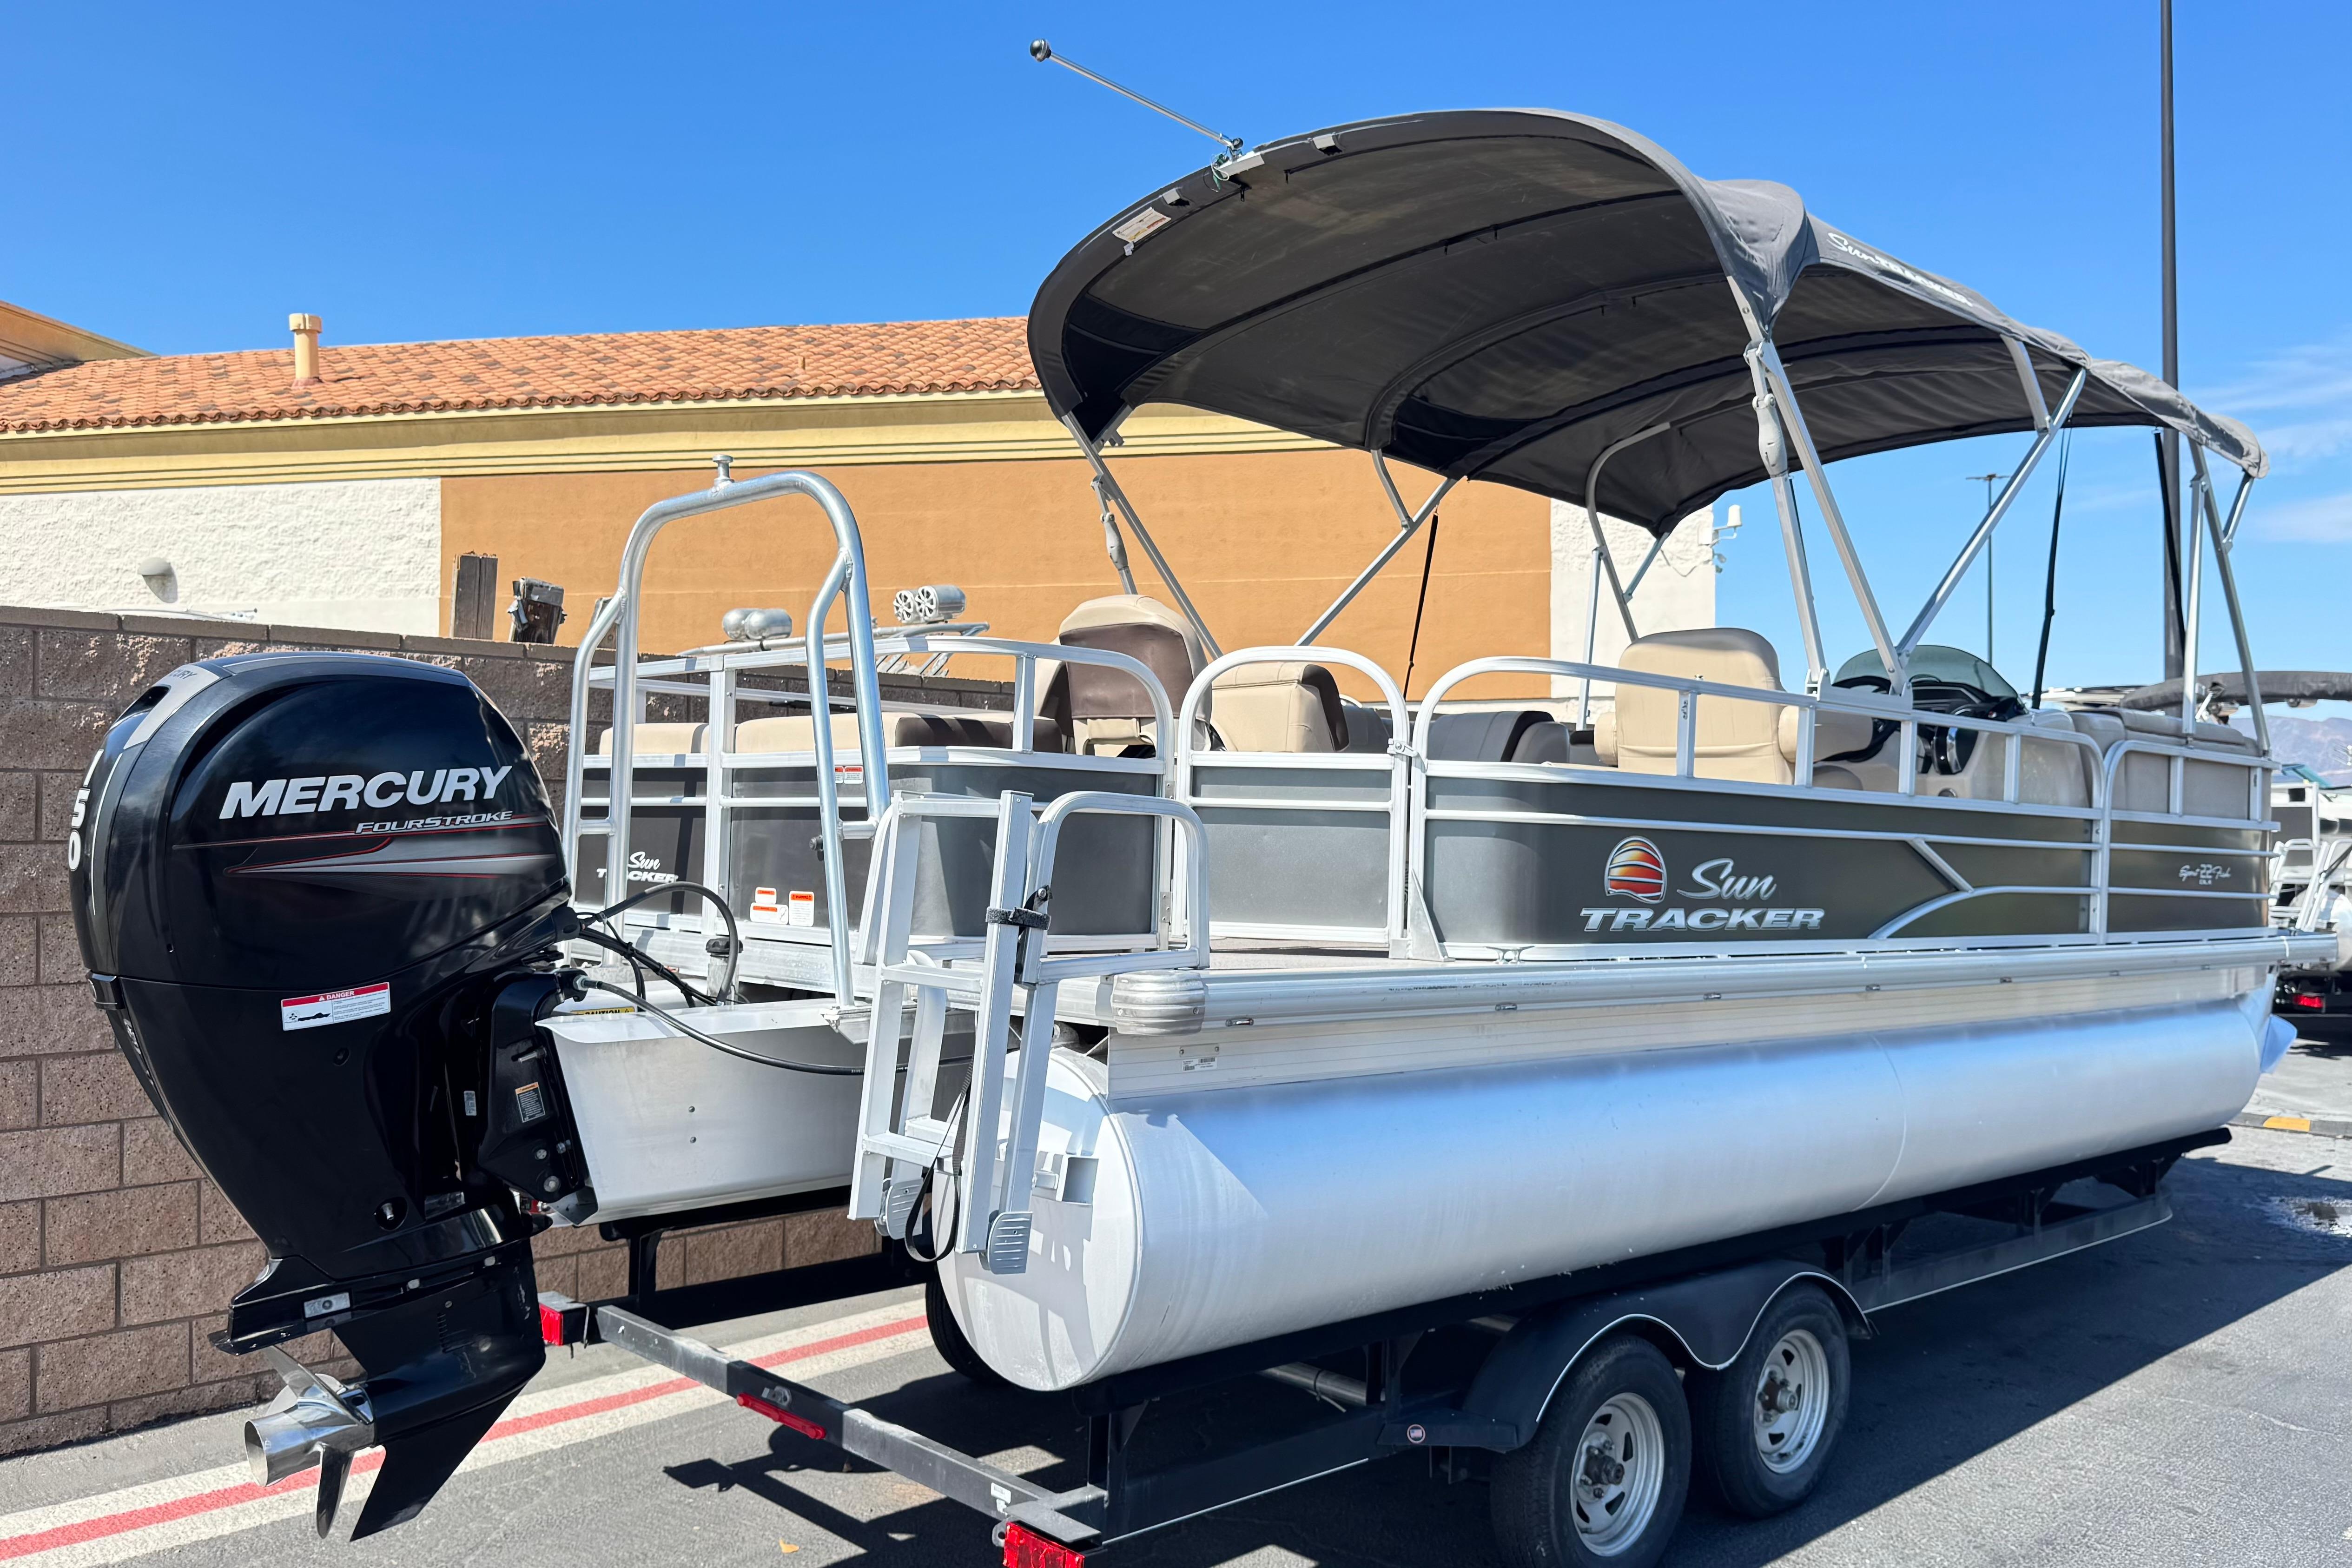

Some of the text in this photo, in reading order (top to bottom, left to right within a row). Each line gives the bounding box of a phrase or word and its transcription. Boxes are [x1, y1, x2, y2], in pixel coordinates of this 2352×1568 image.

[1827, 233, 1879, 264] Sun
[219, 766, 512, 820] MERCURY
[628, 851, 661, 870] Sun
[2200, 864, 2212, 879] 22
[596, 868, 679, 883] TCKER
[1677, 858, 1777, 900] Sun
[1580, 907, 1825, 932] TRACKER
[326, 990, 355, 1000] DANGER
